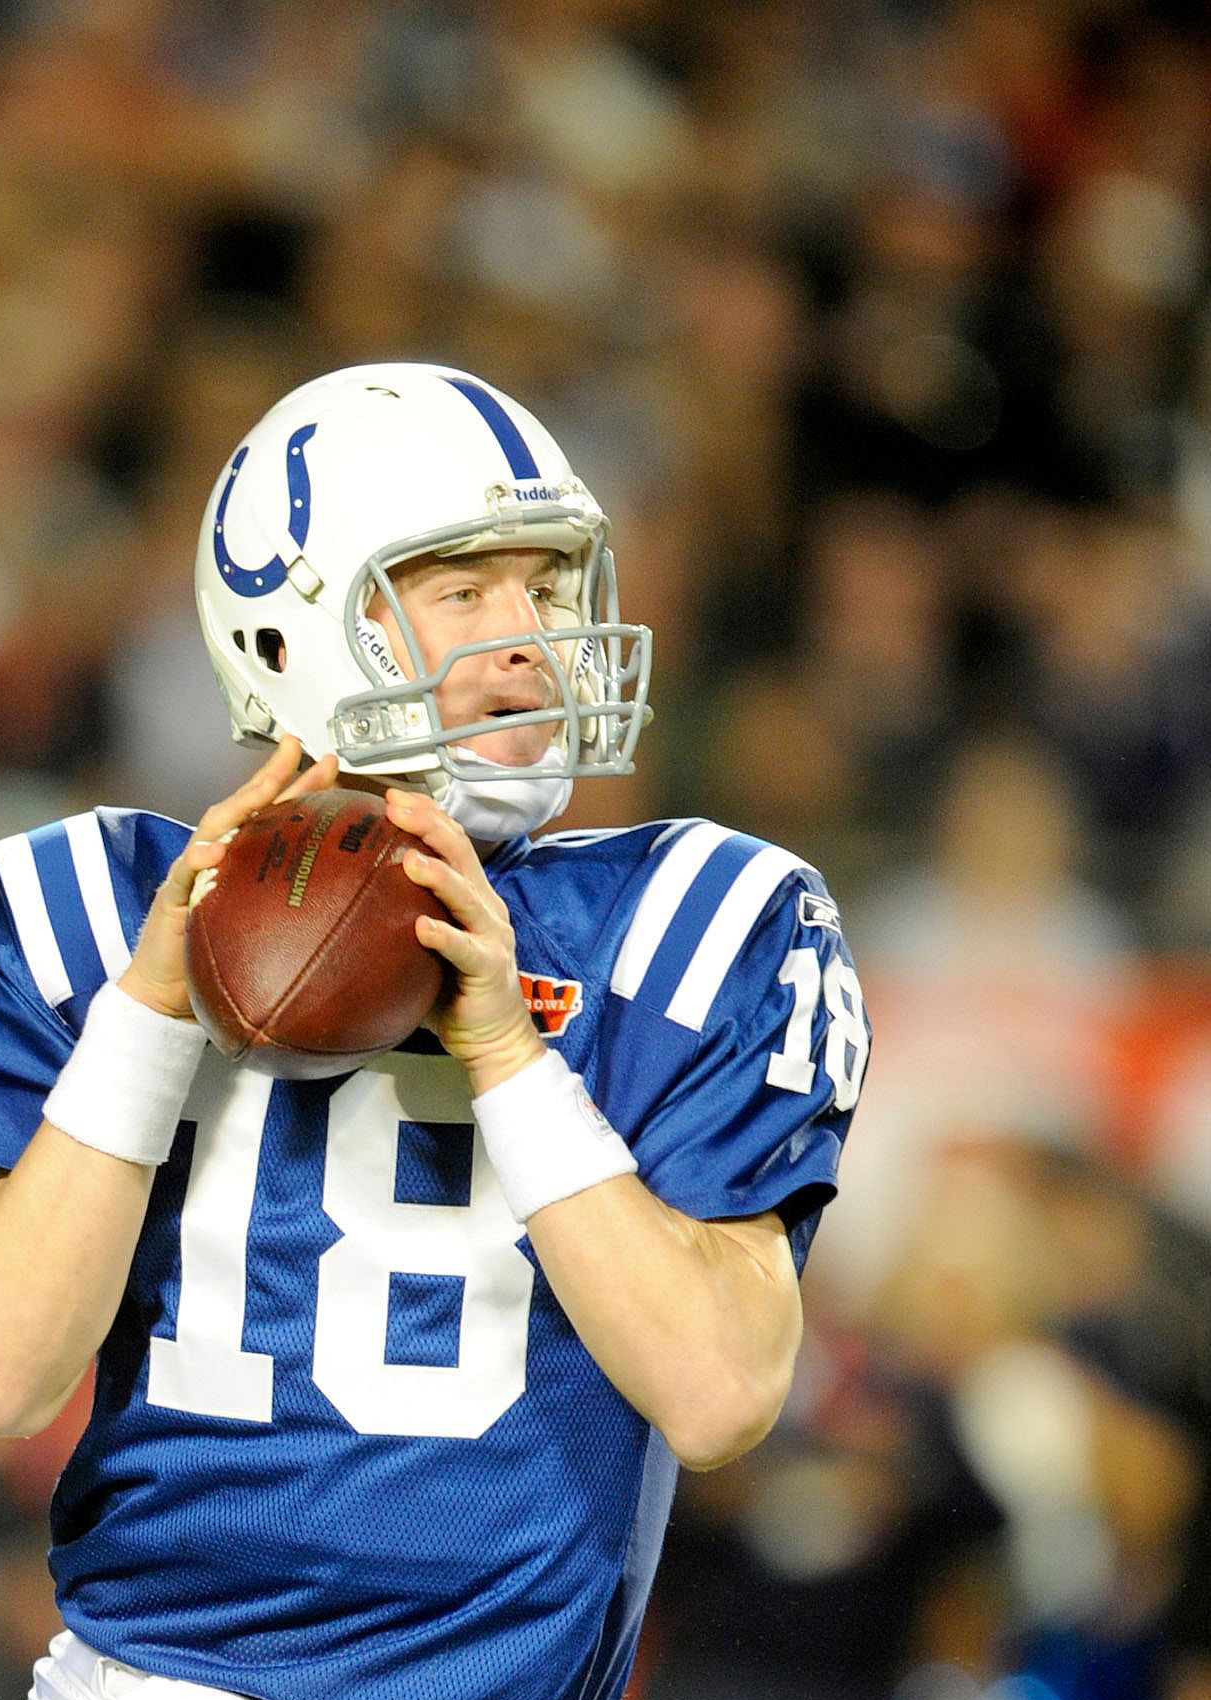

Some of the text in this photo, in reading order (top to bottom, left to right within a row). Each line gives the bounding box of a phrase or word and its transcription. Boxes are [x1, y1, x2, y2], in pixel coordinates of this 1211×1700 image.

[288, 842, 320, 908] NATIONAL
[524, 998, 568, 1012] BOWL
[765, 947, 870, 1111] 18
[146, 1043, 535, 1440] 18
